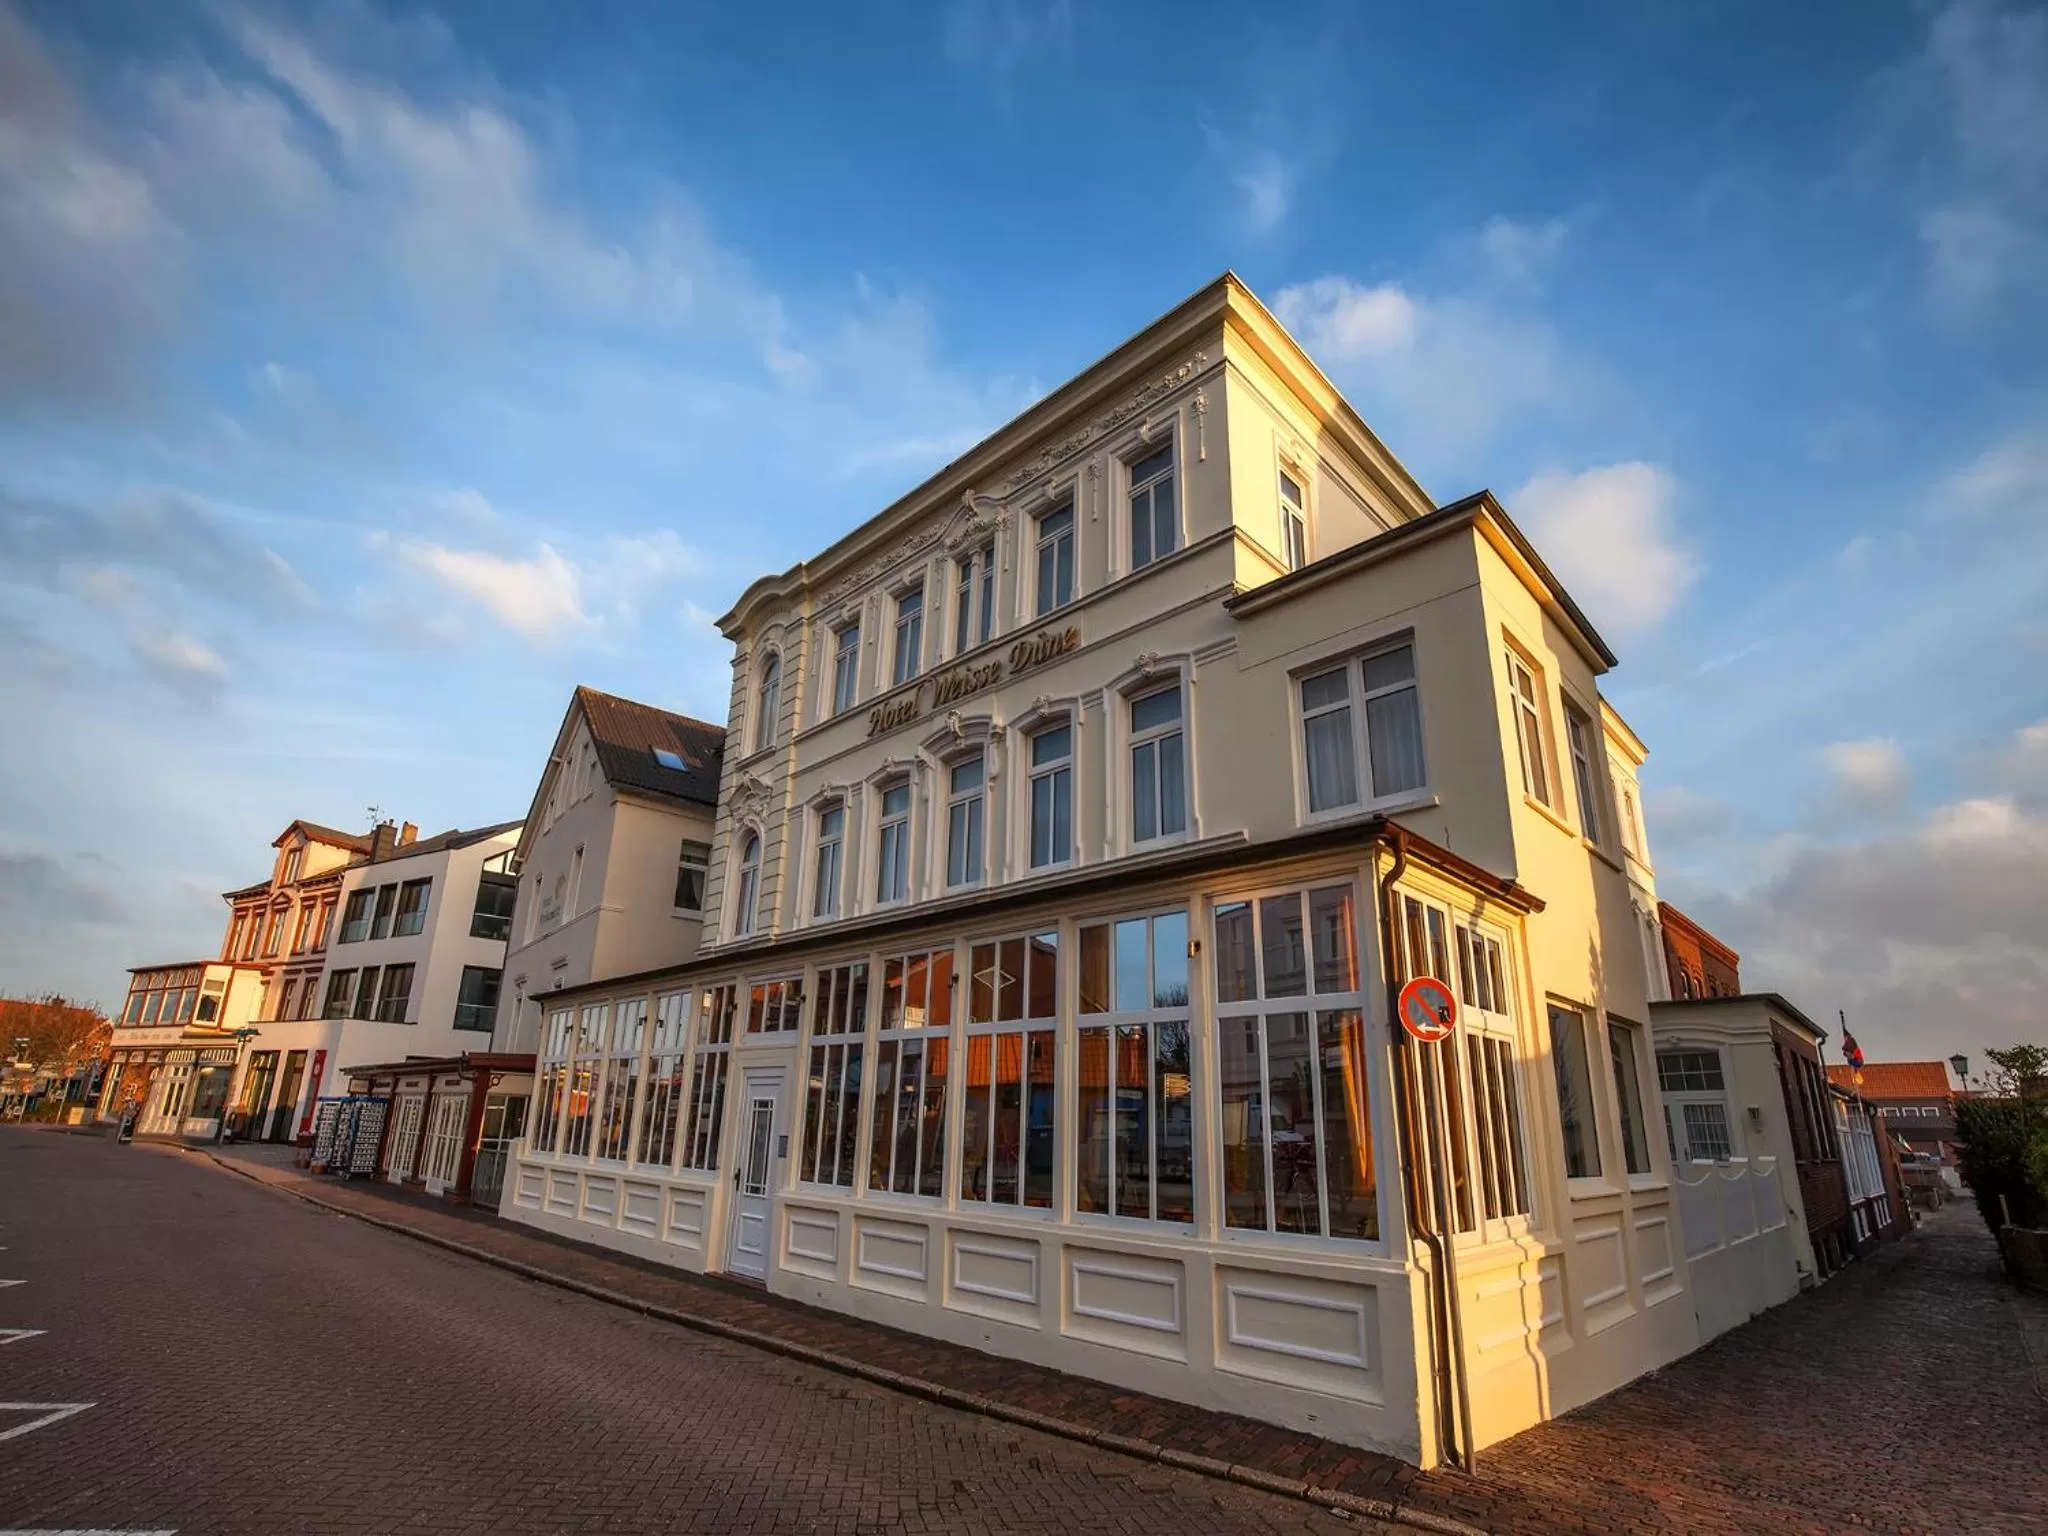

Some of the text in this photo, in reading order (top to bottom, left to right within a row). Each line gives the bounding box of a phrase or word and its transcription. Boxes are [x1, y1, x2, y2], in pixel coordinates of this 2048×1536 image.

[867, 625, 1079, 736] Hotel Weisse Düne
